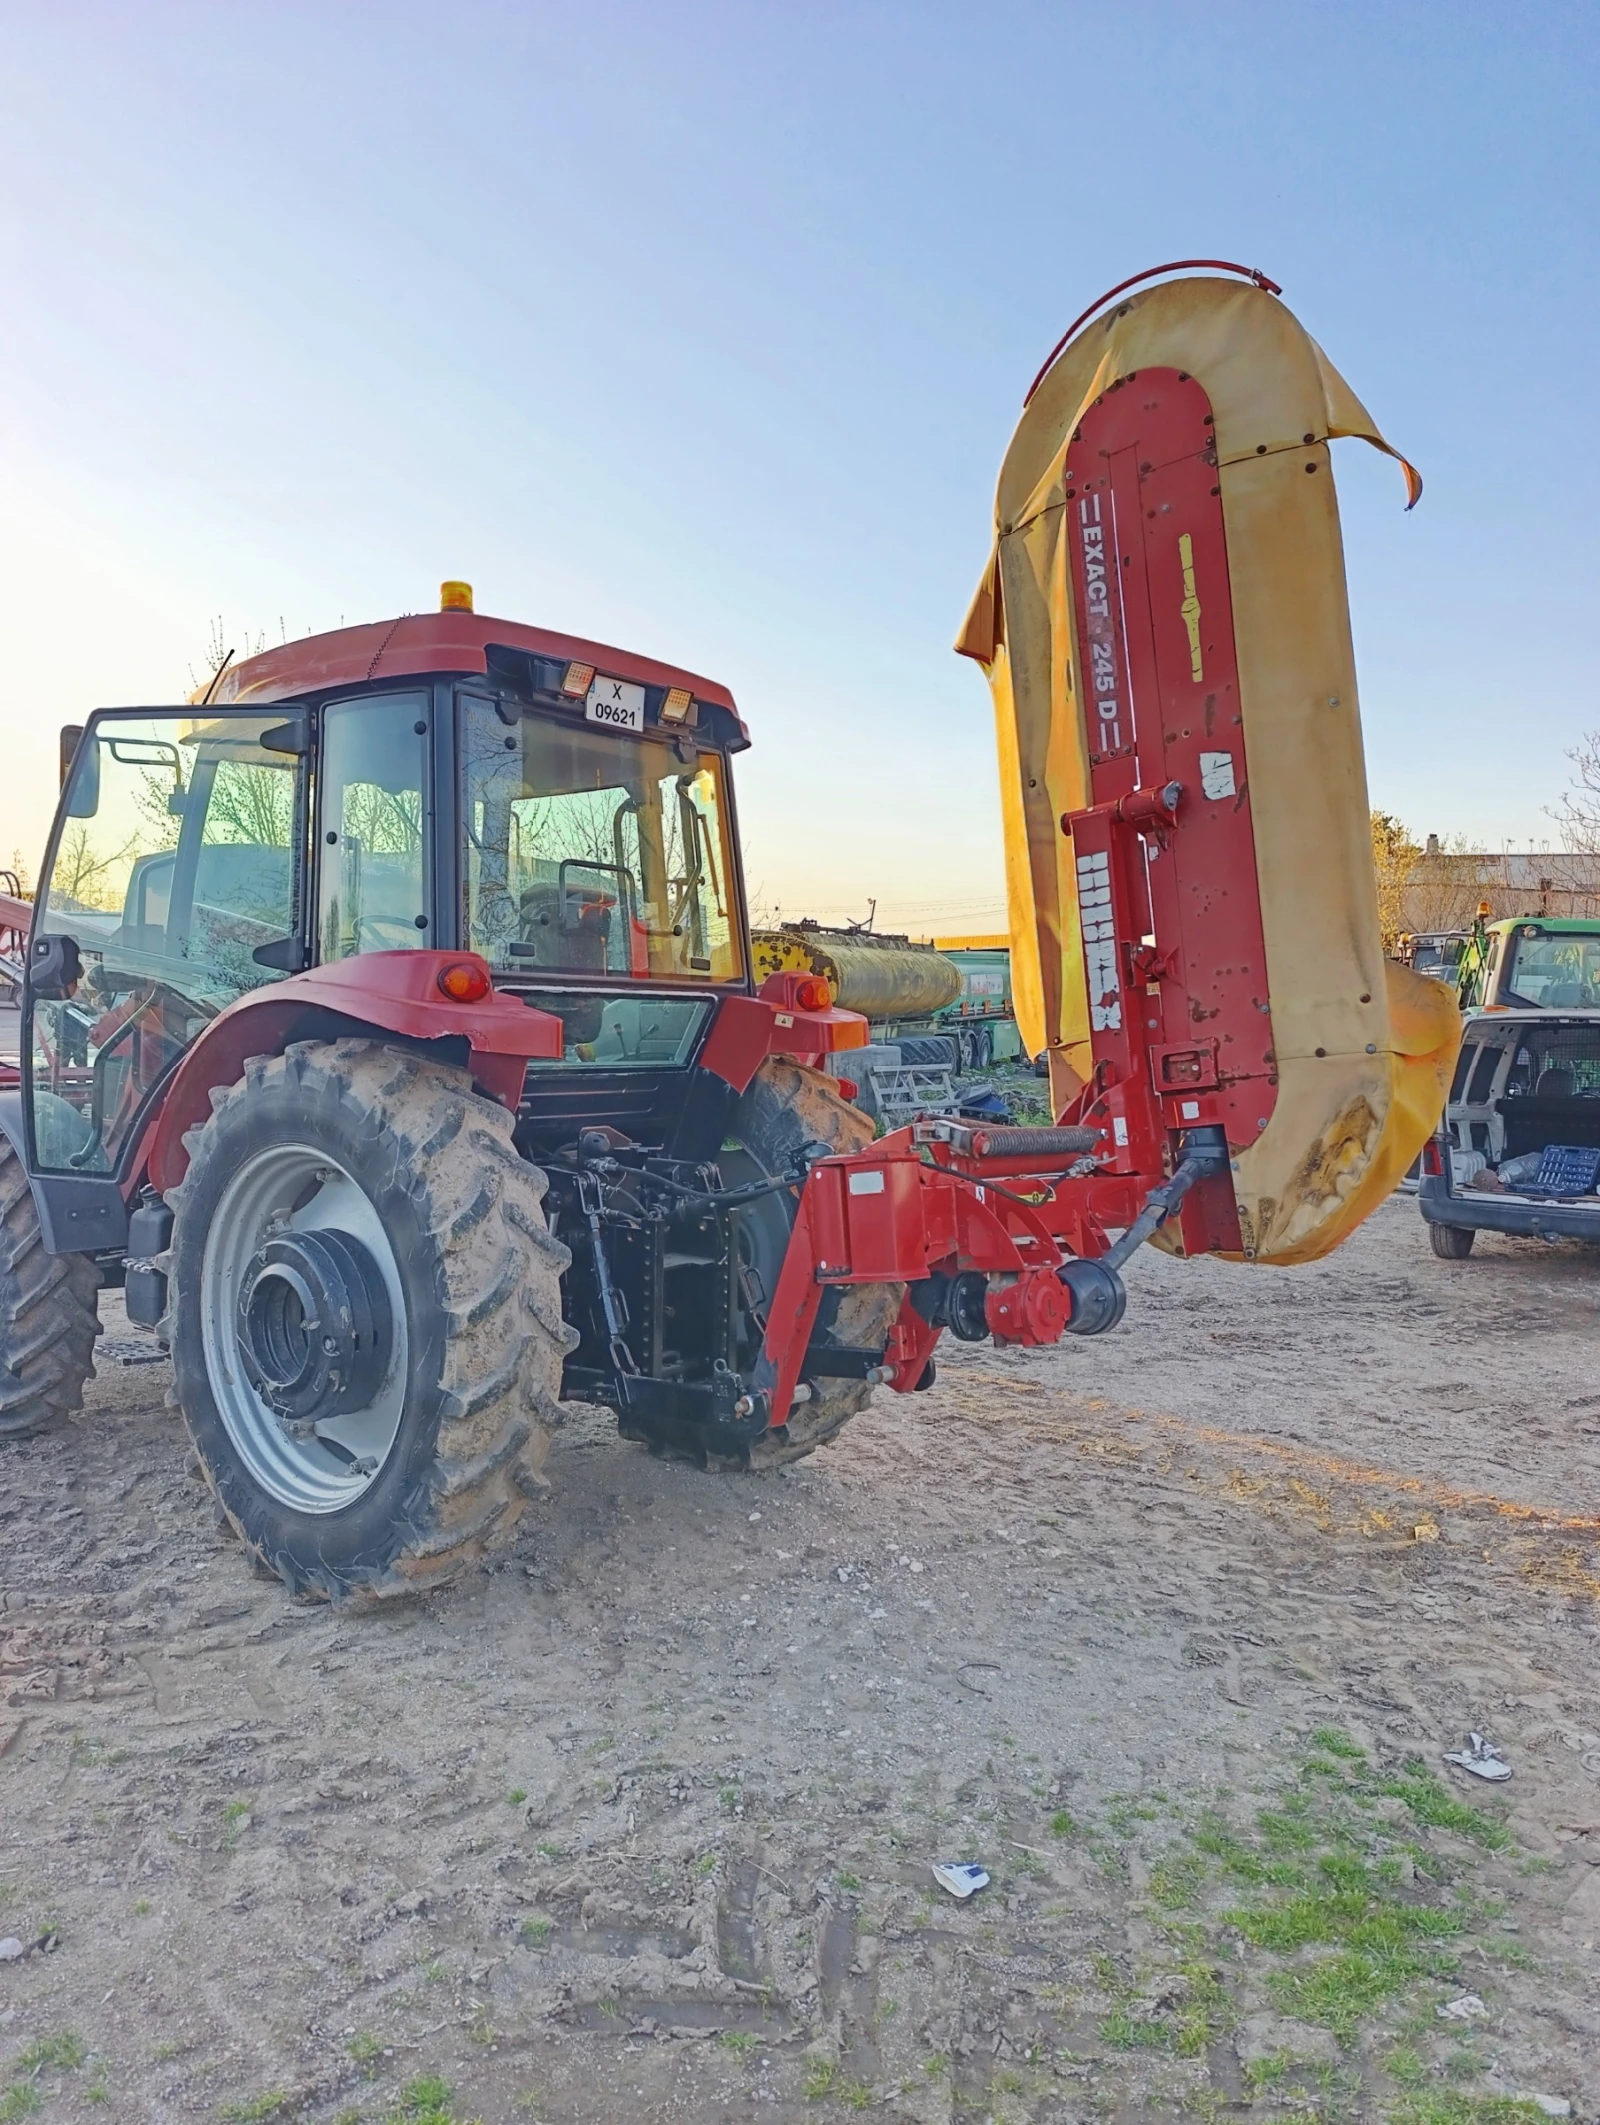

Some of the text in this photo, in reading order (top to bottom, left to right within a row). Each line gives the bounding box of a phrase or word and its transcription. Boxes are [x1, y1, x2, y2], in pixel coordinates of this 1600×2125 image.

[1083, 526, 1117, 719] EXACT 245 D
[612, 683, 622, 700] X
[595, 702, 636, 726] 09621
